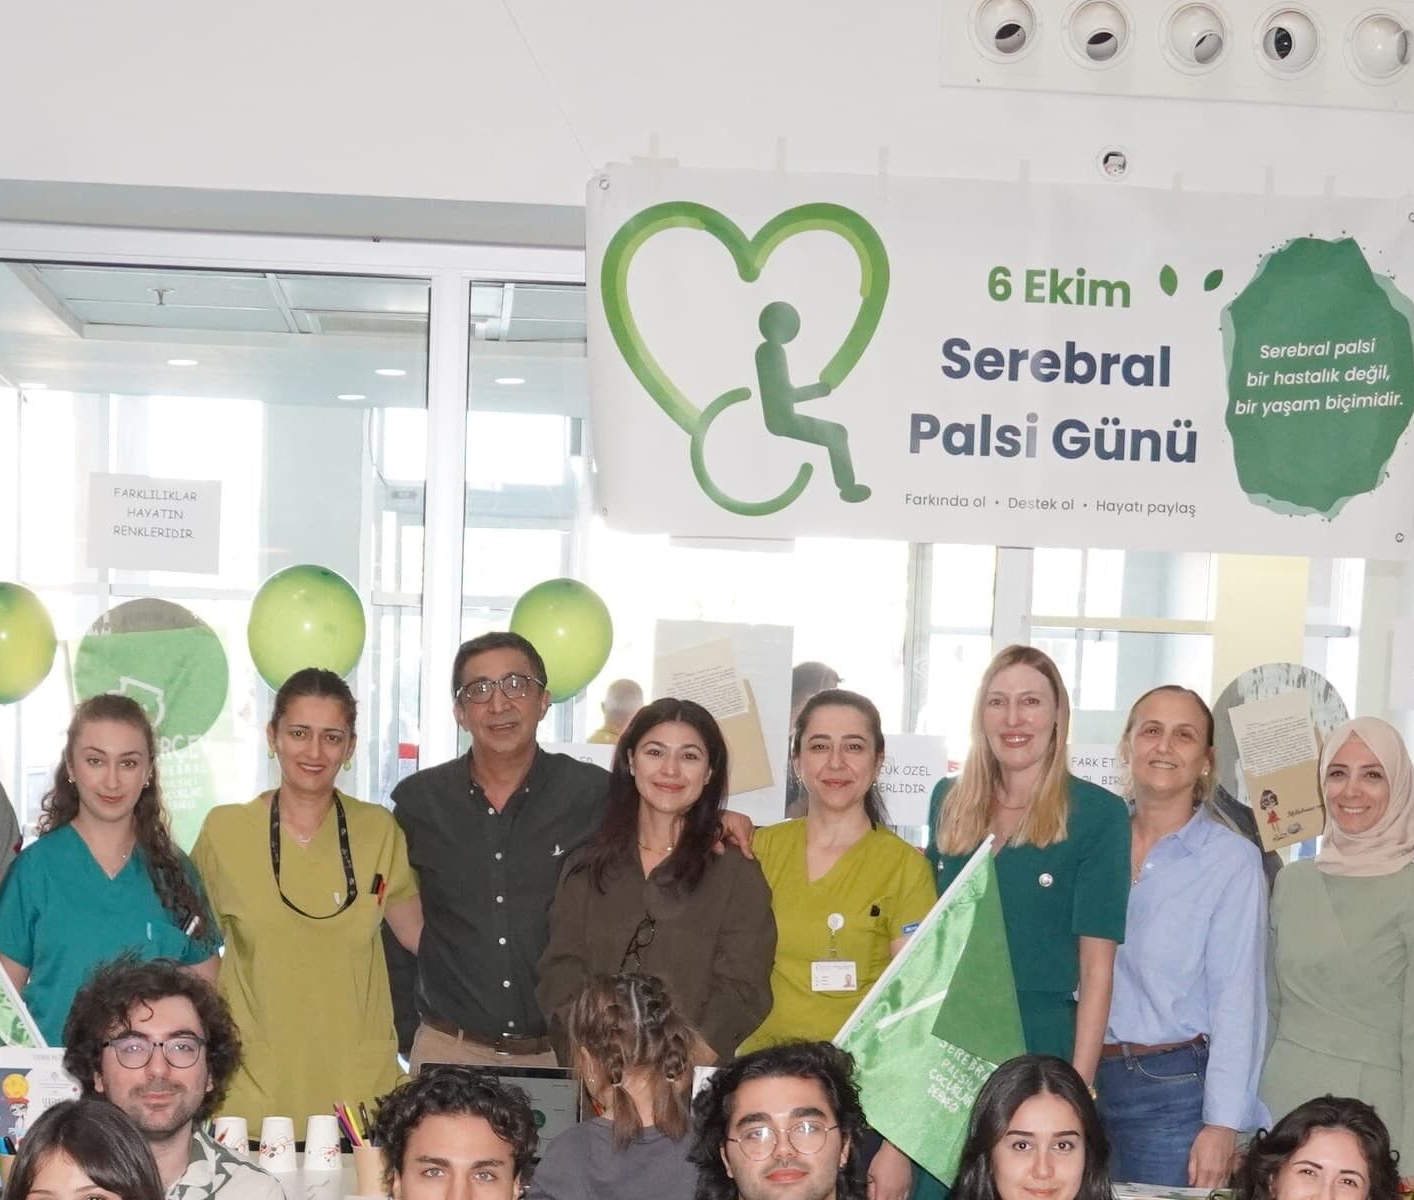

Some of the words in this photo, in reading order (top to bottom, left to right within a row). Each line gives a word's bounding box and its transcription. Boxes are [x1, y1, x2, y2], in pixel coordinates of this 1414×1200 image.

[987, 265, 1013, 303] 6
[1024, 266, 1131, 309] Ekim
[1260, 341, 1331, 360] Serebral
[1334, 337, 1376, 360] palsi
[940, 337, 1172, 388] Serebral
[1246, 371, 1271, 387] bir
[1273, 367, 1340, 385] hastalık
[1344, 364, 1390, 386] değil,
[1234, 399, 1258, 415] bir
[1262, 399, 1321, 419] yaşam
[1325, 391, 1404, 416] biçimidir.
[909, 411, 1039, 459] Palsi
[1051, 412, 1198, 464] Günü
[113, 487, 197, 501] FARKLILIKLAR
[905, 492, 967, 509] Farkında
[969, 494, 986, 509] ol
[1008, 496, 1057, 510] Destek
[1060, 497, 1075, 511] ol
[1096, 499, 1143, 517] Hayatı
[1147, 500, 1196, 519] paylaş
[126, 508, 184, 519] HAYATIN
[938, 1040, 992, 1082] SEREBRA
